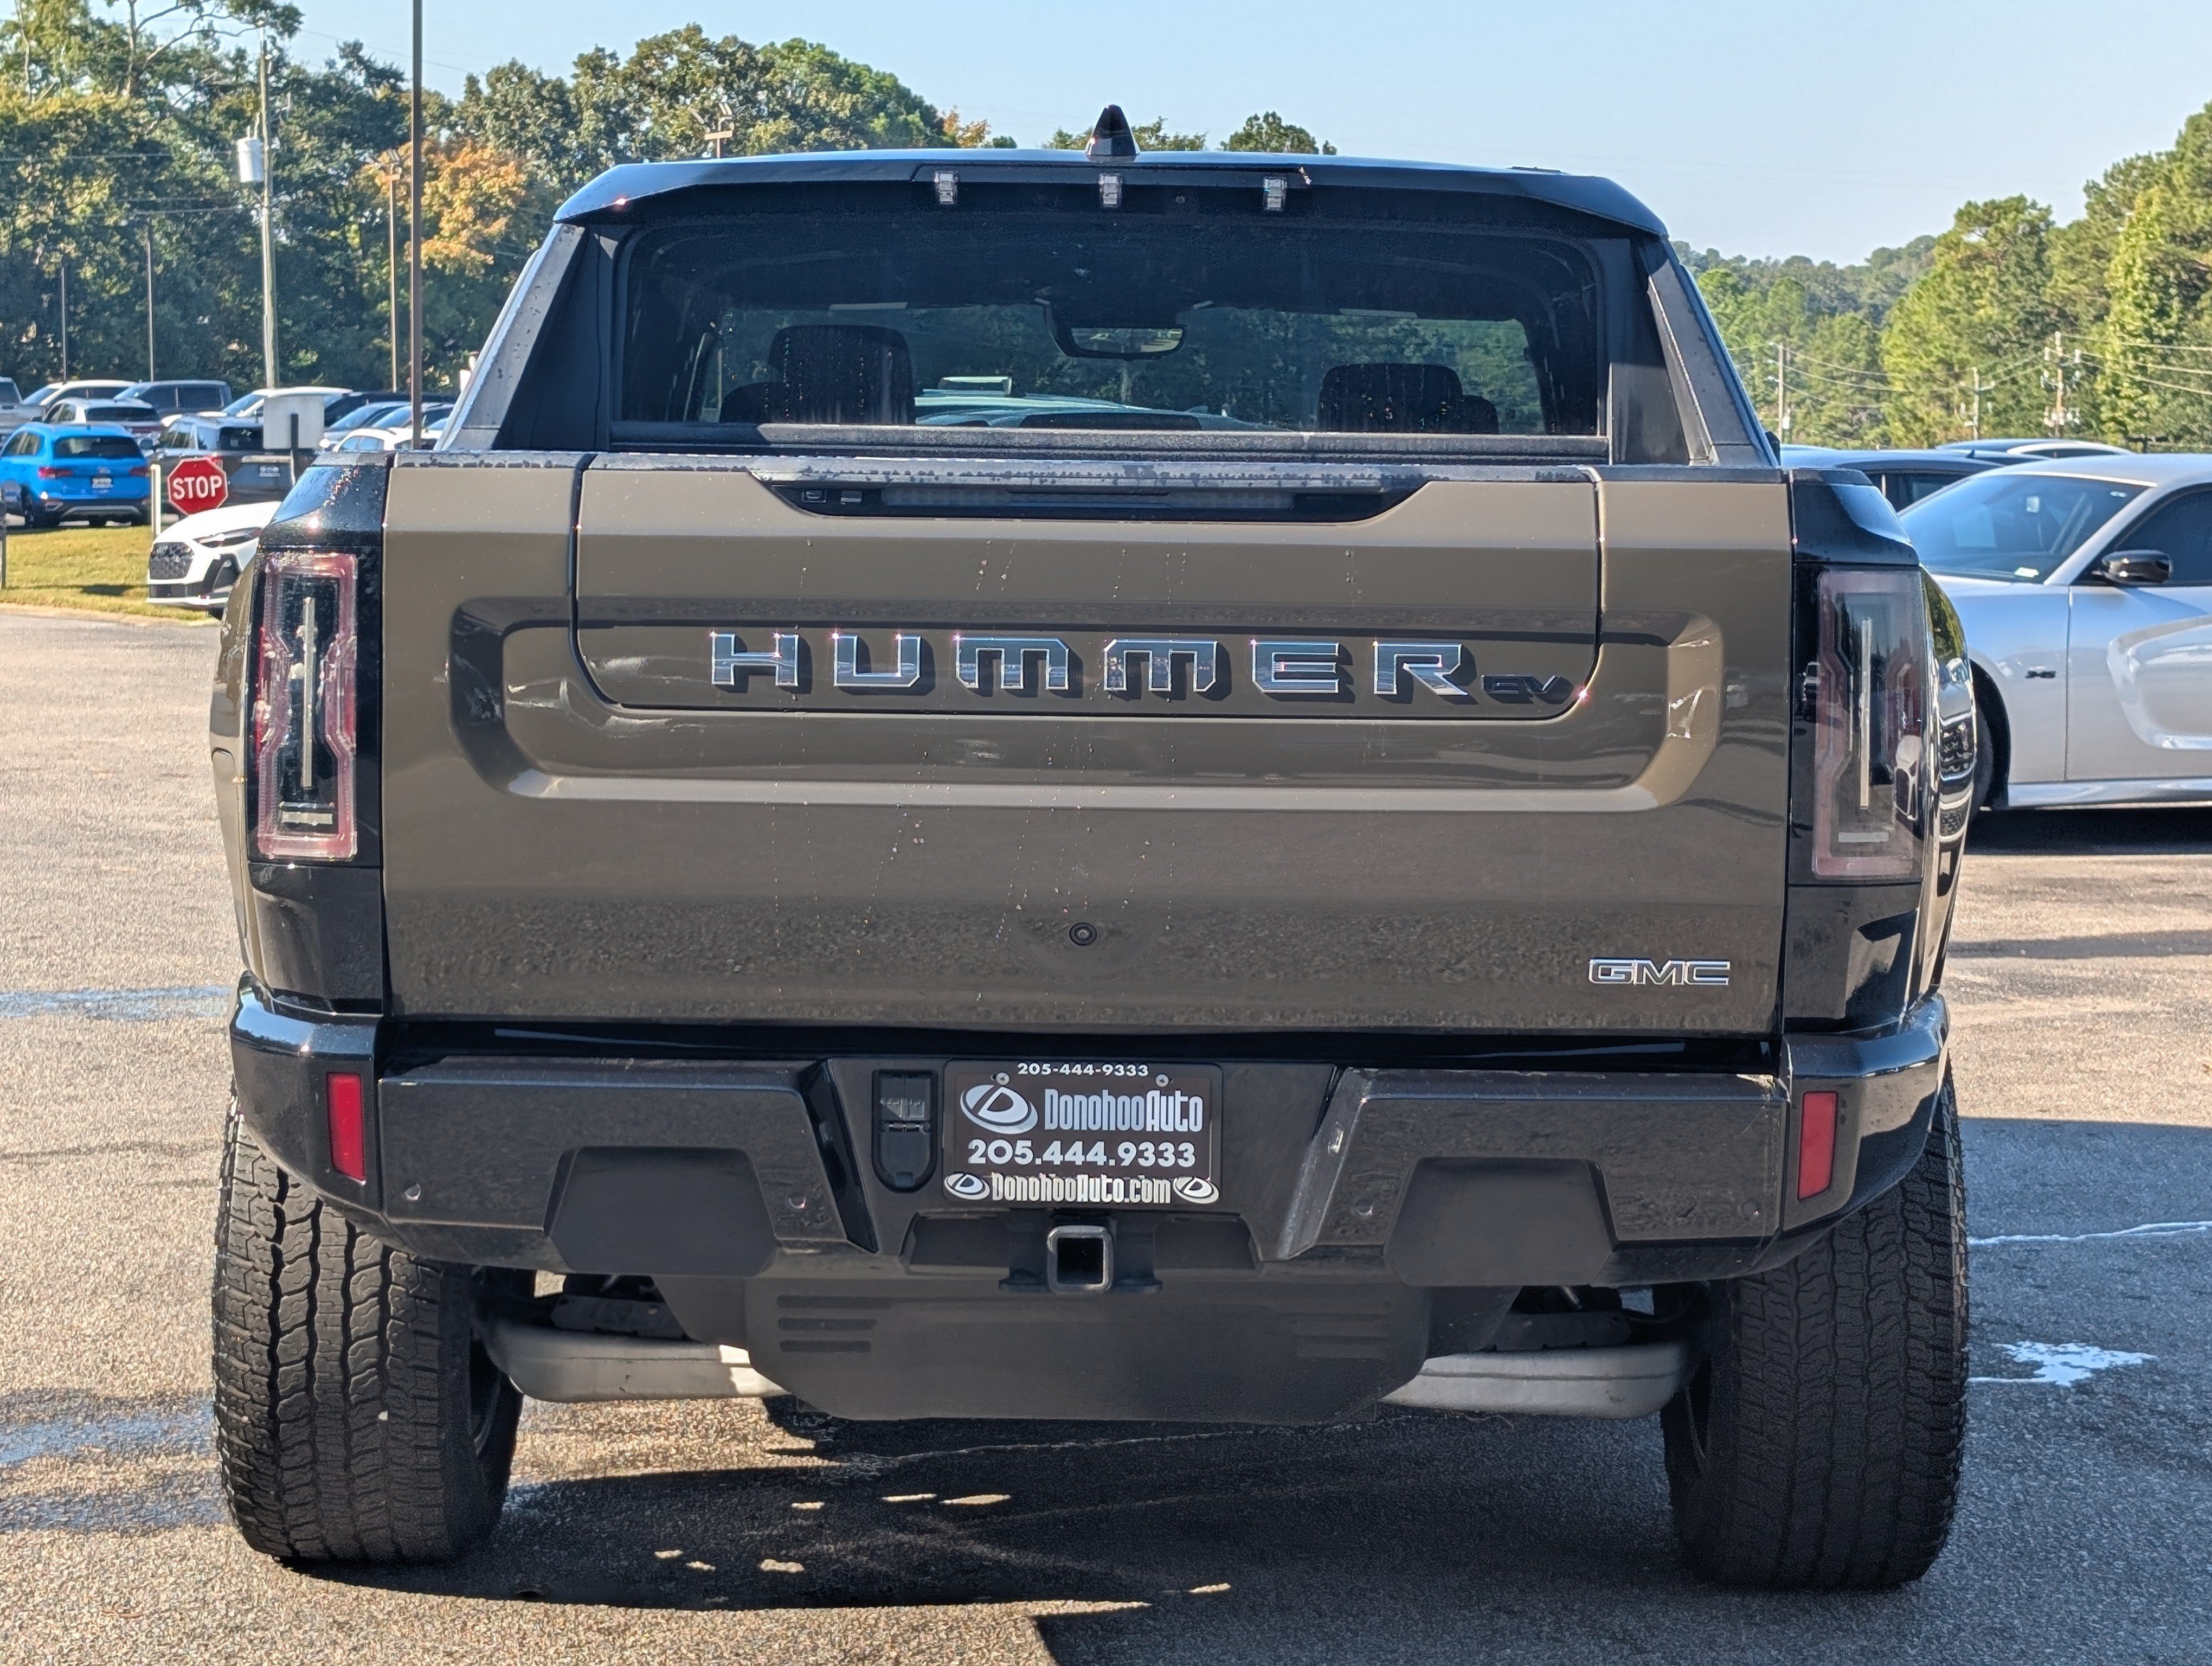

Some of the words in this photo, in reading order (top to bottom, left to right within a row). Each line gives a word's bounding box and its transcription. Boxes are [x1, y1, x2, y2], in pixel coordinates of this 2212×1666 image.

[172, 475, 223, 500] STOP
[711, 632, 1469, 696] HUMMER
[1481, 674, 1562, 694] EV
[1589, 958, 1731, 986] GMC
[1017, 1062, 1149, 1077] 205-444-9333
[1044, 1088, 1204, 1132] DonohooAuto
[968, 1139, 1196, 1168] 205.444.9333
[992, 1172, 1171, 1204] DonohooAuto.com
